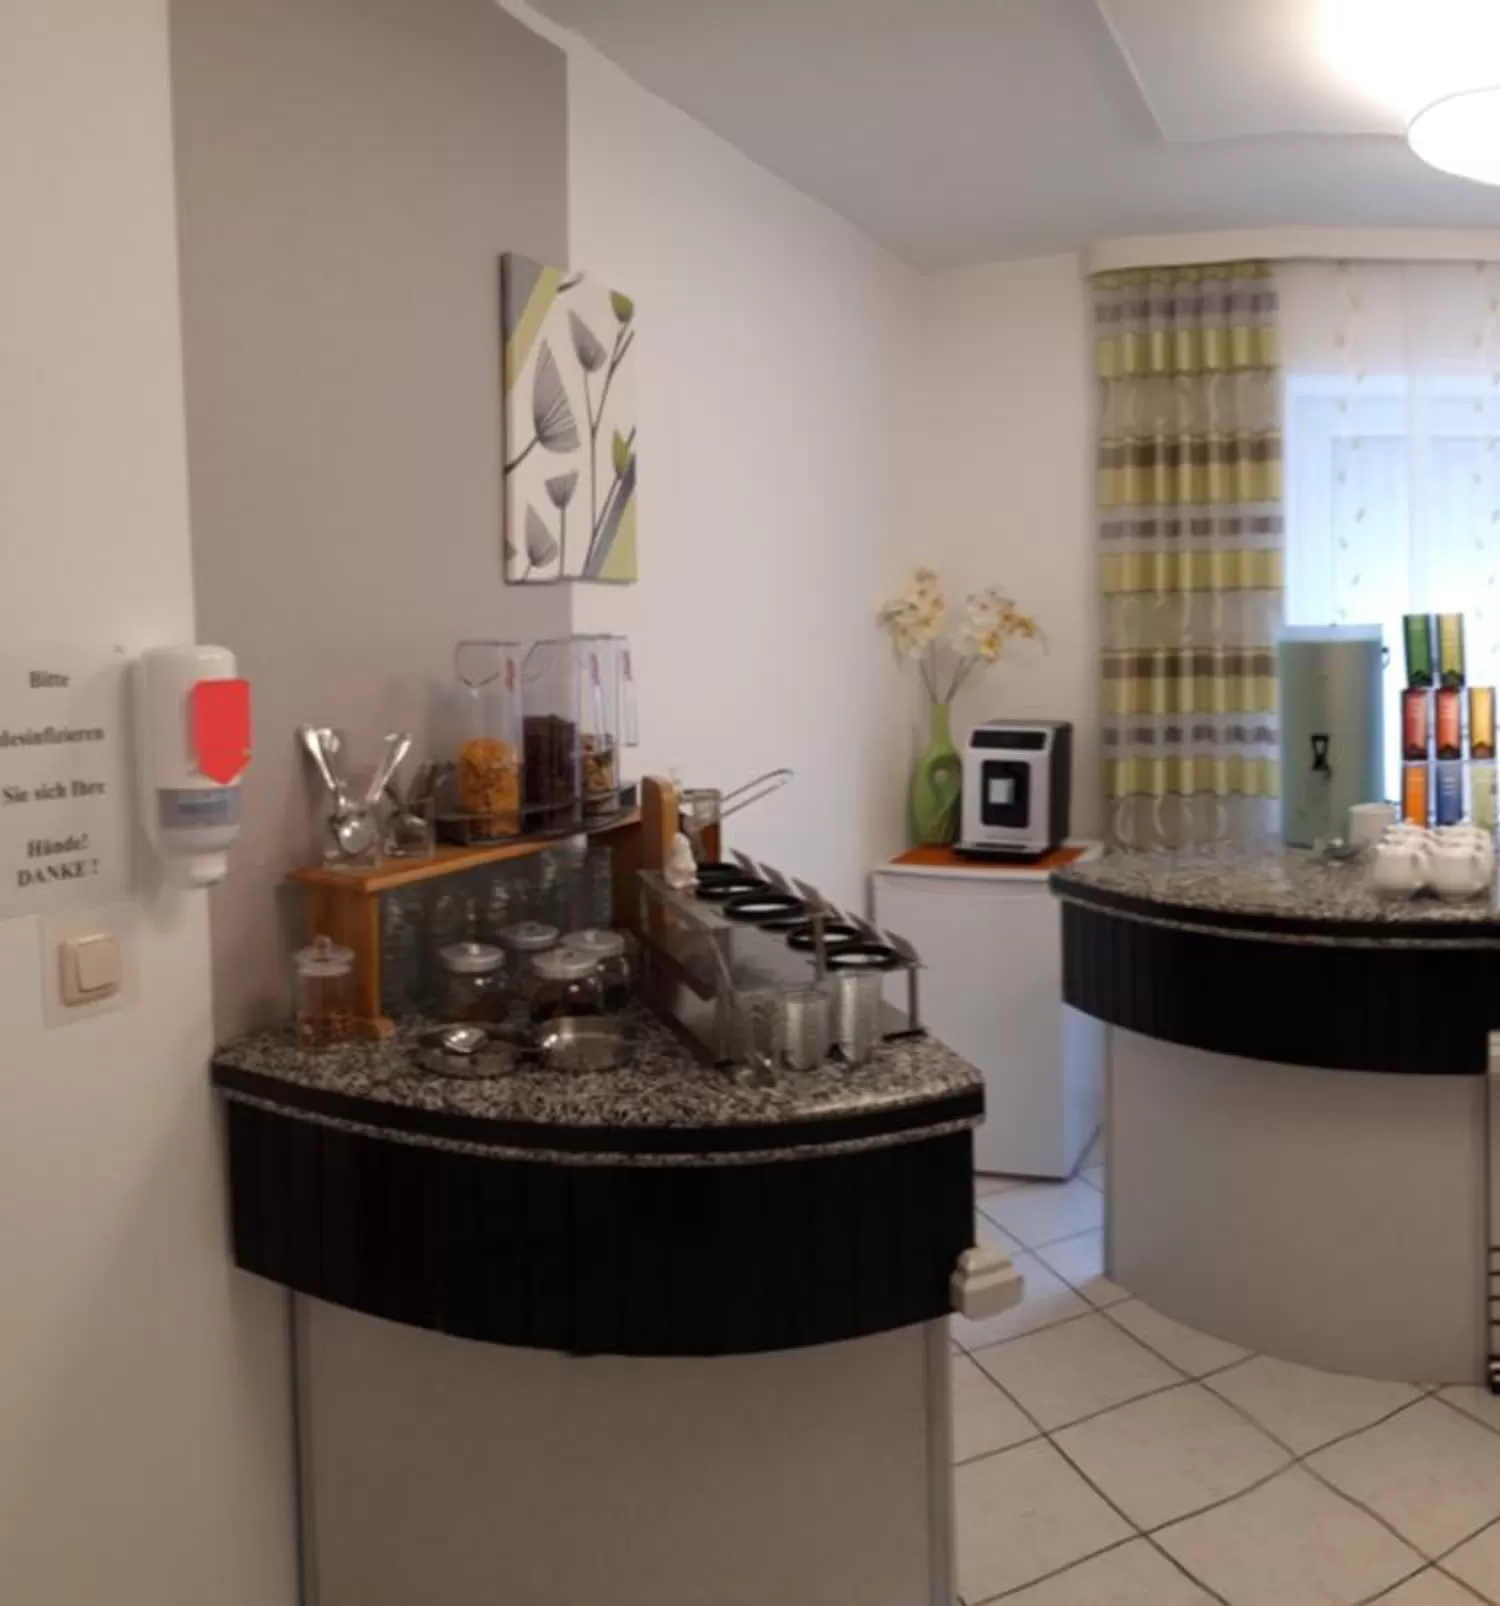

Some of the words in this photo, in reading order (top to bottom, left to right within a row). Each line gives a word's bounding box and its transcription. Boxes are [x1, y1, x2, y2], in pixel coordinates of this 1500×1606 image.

[29, 670, 69, 689] Bitte
[3, 784, 28, 803] Sie
[35, 781, 66, 801] sich
[71, 779, 105, 798] Ihre
[17, 861, 84, 887] DANKE
